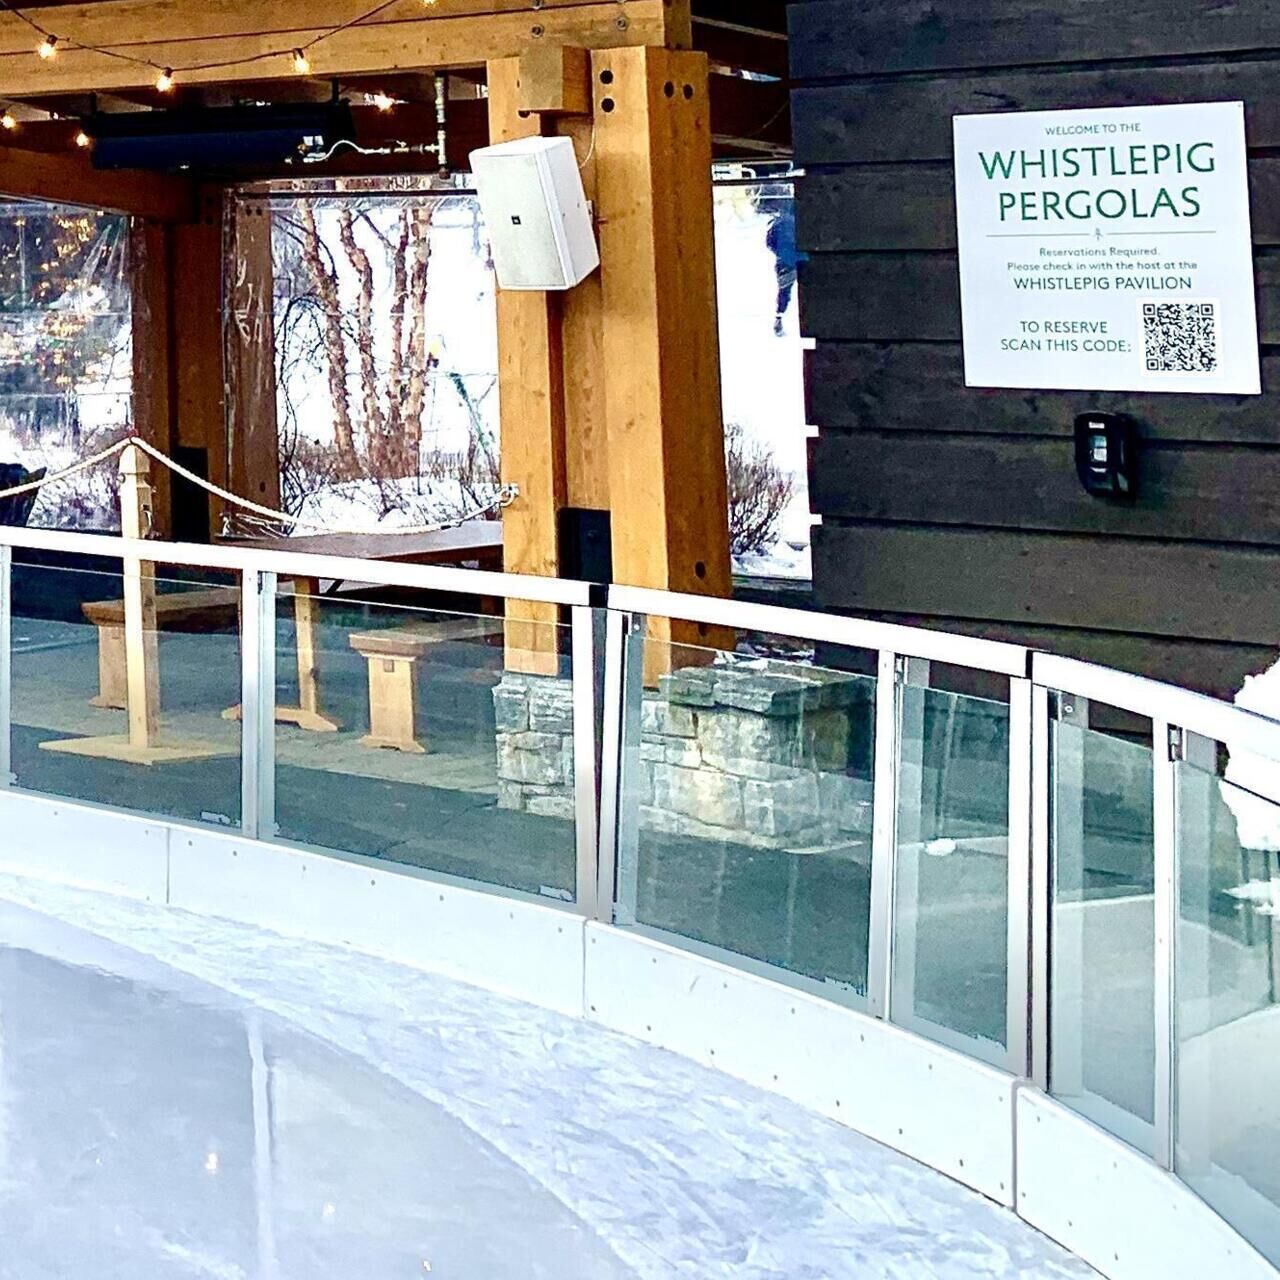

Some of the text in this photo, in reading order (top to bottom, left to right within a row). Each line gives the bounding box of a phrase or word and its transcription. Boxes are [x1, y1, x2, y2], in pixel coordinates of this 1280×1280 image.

[1044, 122, 1142, 136] WELCOME TO THE
[977, 141, 1216, 180] WHISTLEPIG
[999, 186, 1201, 222] PERGOLAS
[1039, 247, 1107, 257] Reservations
[1006, 260, 1198, 272] Please check in with the host at the
[1013, 276, 1192, 291] WHISTLEPIG PAVILION
[1019, 320, 1108, 334] TO RESERVE
[1000, 338, 1132, 353] SCAN THIS CODE:
